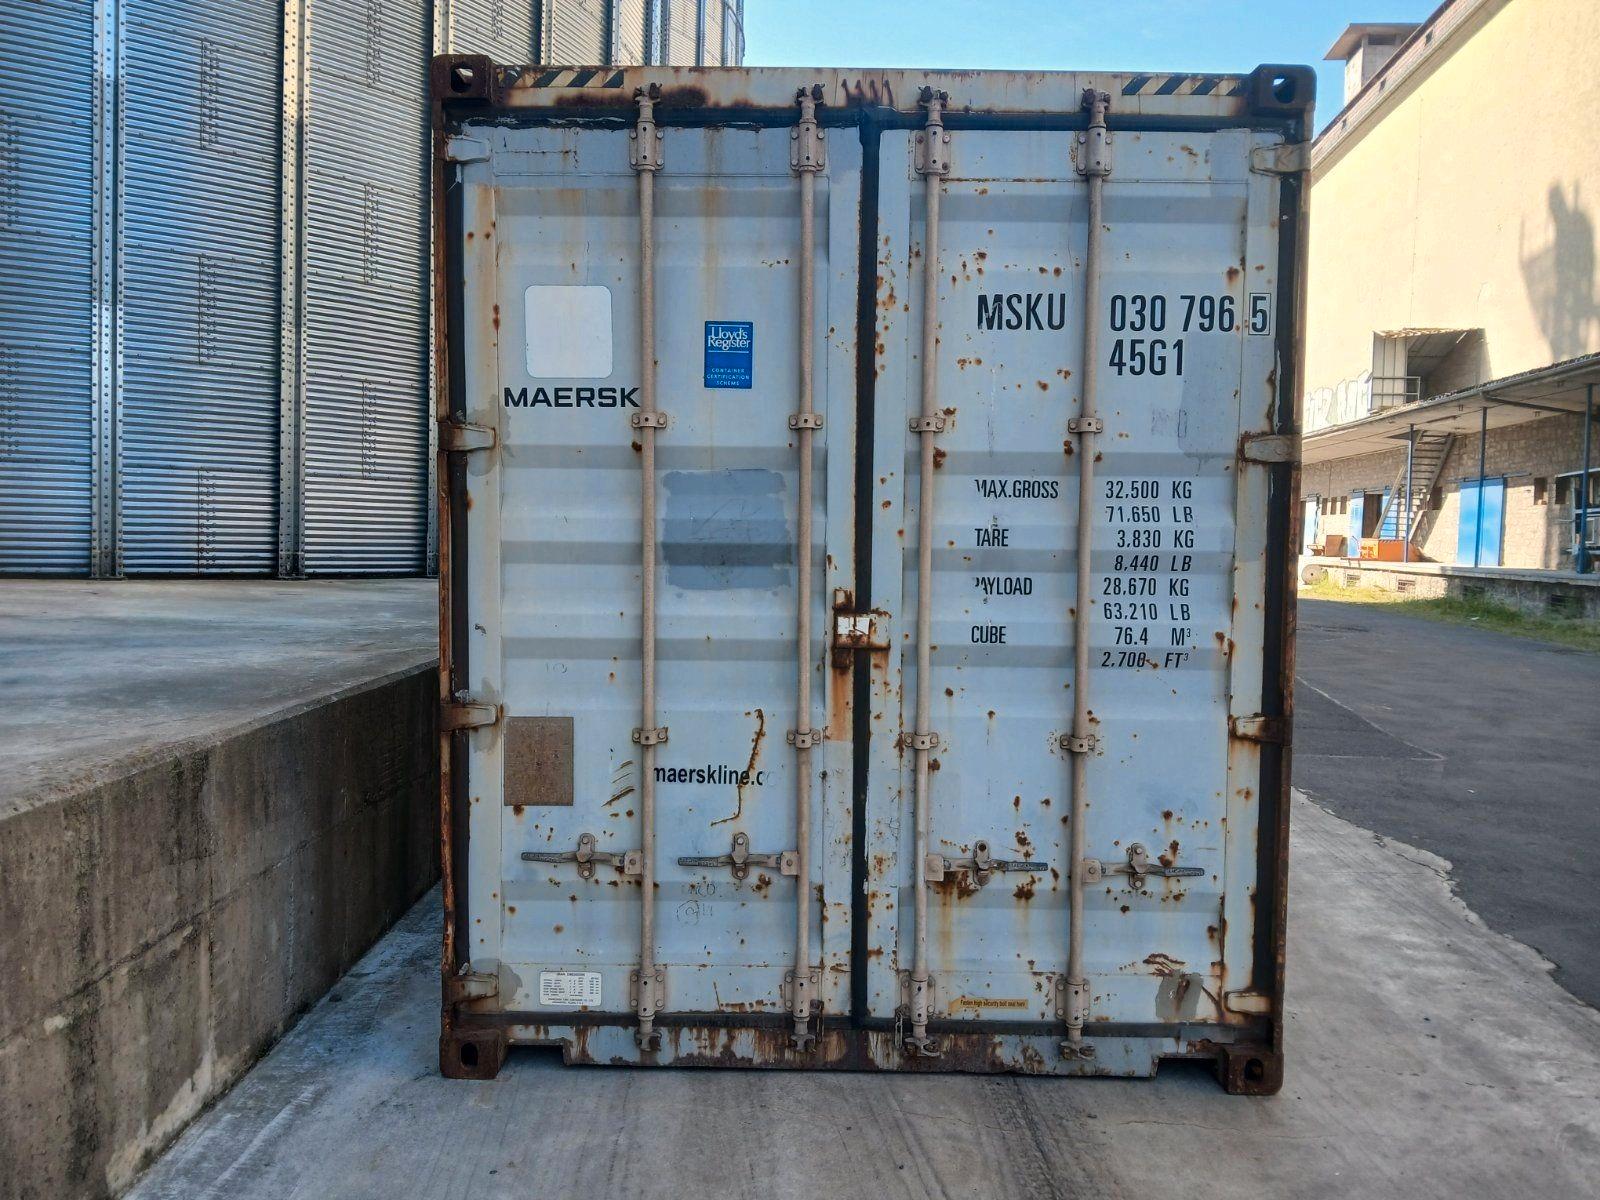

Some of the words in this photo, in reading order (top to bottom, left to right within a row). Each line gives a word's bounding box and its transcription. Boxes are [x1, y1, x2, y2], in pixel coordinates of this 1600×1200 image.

[977, 293, 1066, 331] MSKU
[1110, 294, 1166, 332] 030
[1180, 295, 1235, 333] 796
[1251, 296, 1268, 333] 5
[707, 335, 751, 351] Register
[711, 326, 748, 341] Lloyd's
[1108, 338, 1184, 376] 45G1
[503, 387, 641, 408] MAERSK
[974, 479, 1059, 499] MAX.GROSS
[1105, 480, 1159, 499] 32,500
[1172, 480, 1192, 499] KG
[1172, 505, 1194, 523] LB
[974, 528, 1009, 547] TARE
[1117, 529, 1161, 548] 3,830
[1173, 529, 1194, 548] KG
[1170, 555, 1192, 572] LB
[1103, 577, 1157, 596] 28,670
[1169, 578, 1189, 597] KG
[1169, 603, 1191, 621] LB
[971, 625, 1007, 644] CUBE
[1114, 626, 1149, 645] 76.4
